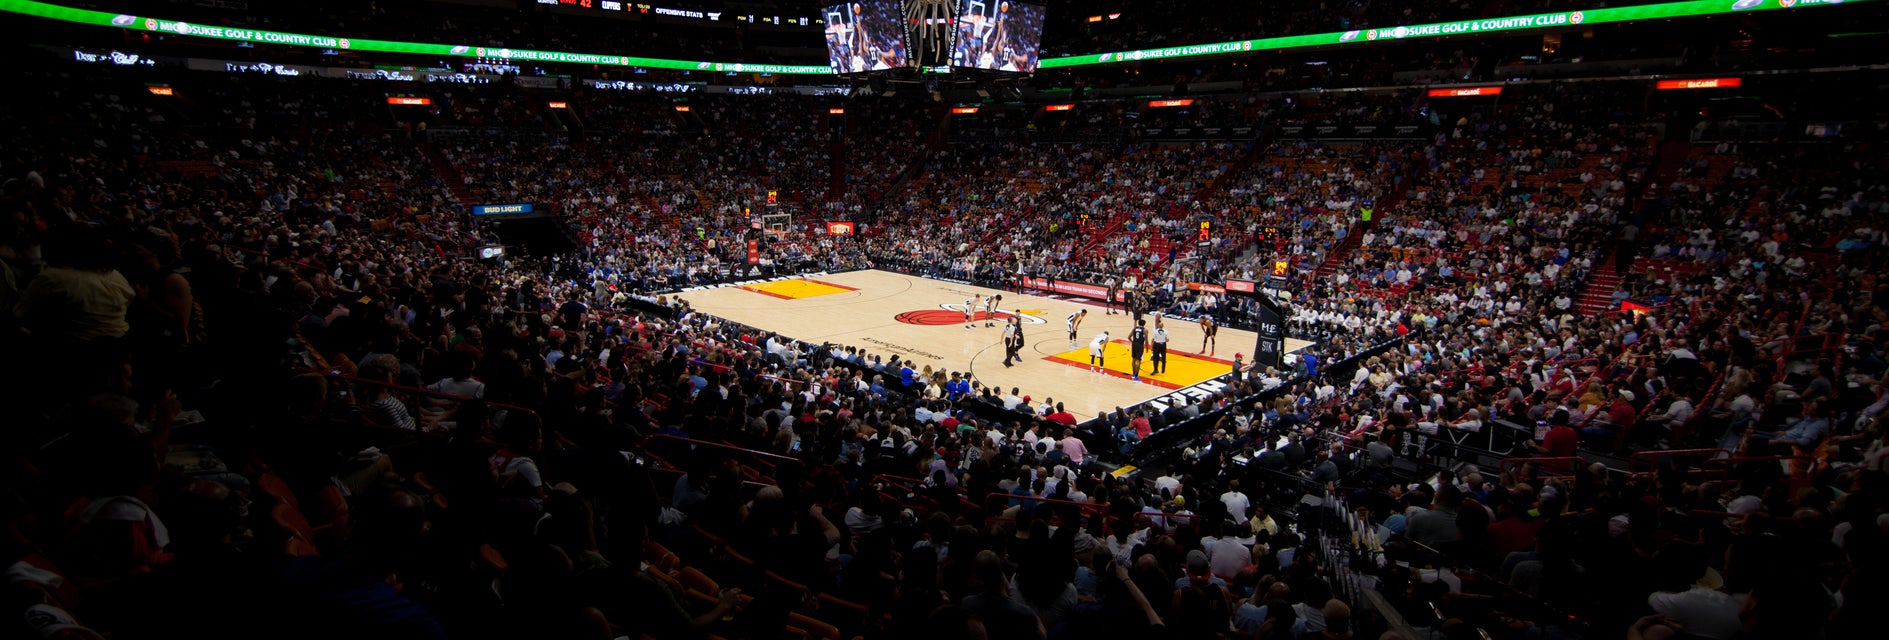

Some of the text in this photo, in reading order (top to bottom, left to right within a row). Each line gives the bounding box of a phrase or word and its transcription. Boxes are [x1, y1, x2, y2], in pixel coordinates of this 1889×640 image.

[601, 0, 621, 11] CLIPPERS
[655, 7, 685, 16] OFFENSIVE
[1380, 14, 1566, 38] MICOSUKEE GOLF & COUNTRY CLUB
[159, 21, 337, 47] MICOSUKEE GOLF & COUNTRY CLUB
[487, 49, 537, 59] MICOSUKEE
[539, 52, 558, 60] GOLF
[567, 54, 600, 63] COUNTRY
[601, 56, 619, 64] CLUB
[1124, 50, 1163, 60] MICOSUKEE
[1164, 48, 1181, 56] GOLF
[1188, 45, 1221, 54] COUNTRY
[1223, 43, 1241, 51] CLUB
[724, 64, 764, 72] MICOSUKEE
[765, 65, 781, 73] GOLF
[788, 65, 817, 73] COUNTRY
[767, 195, 777, 204] 24
[1088, 288, 1107, 296] SECONDS
[1261, 341, 1273, 353] STK
